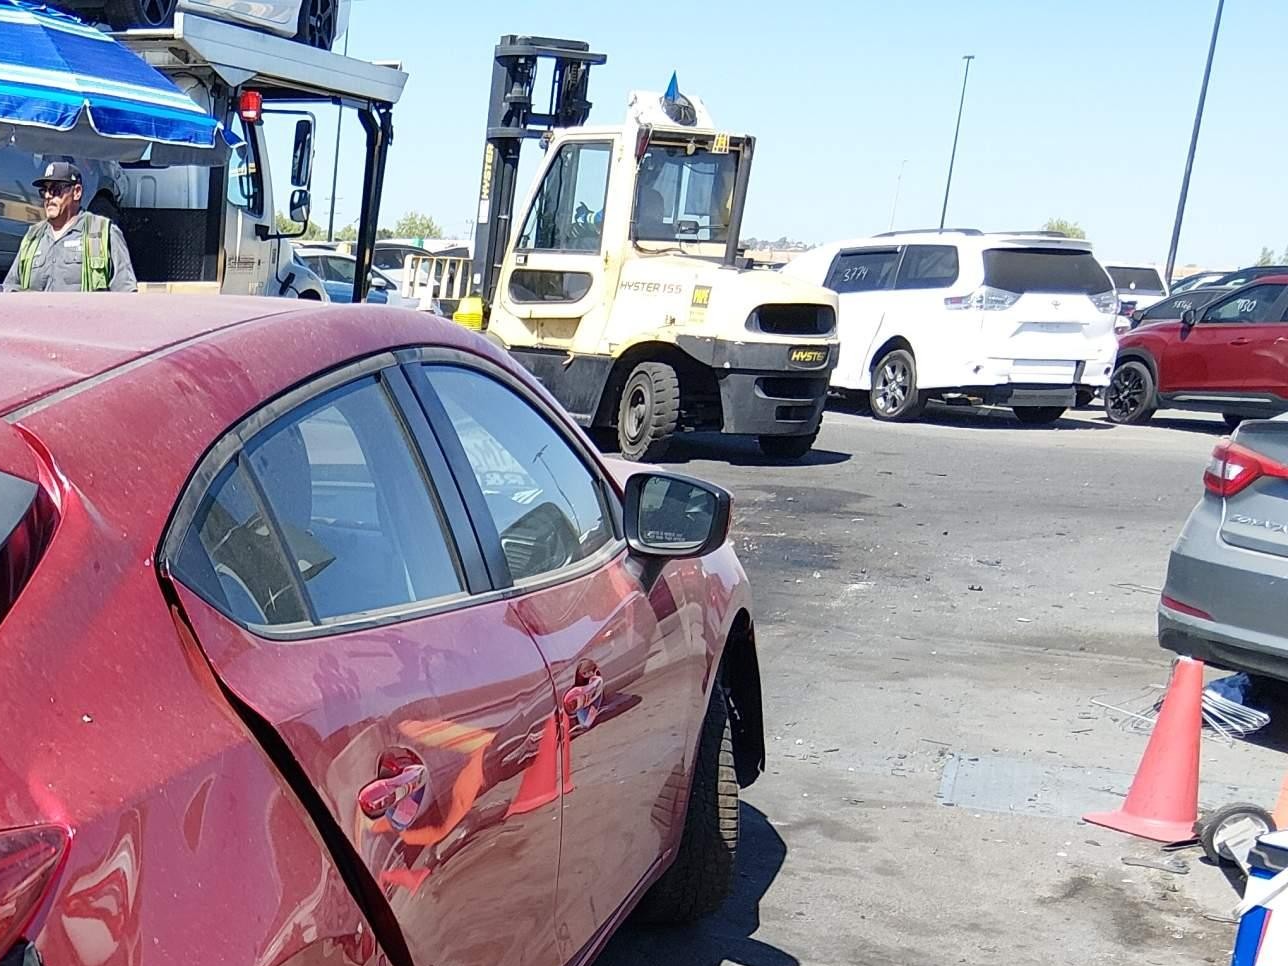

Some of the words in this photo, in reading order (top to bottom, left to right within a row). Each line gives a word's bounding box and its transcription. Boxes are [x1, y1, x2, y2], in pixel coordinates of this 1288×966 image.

[481, 143, 494, 200] HYSTER
[620, 281, 661, 293] HYSTER
[663, 284, 683, 294] 155
